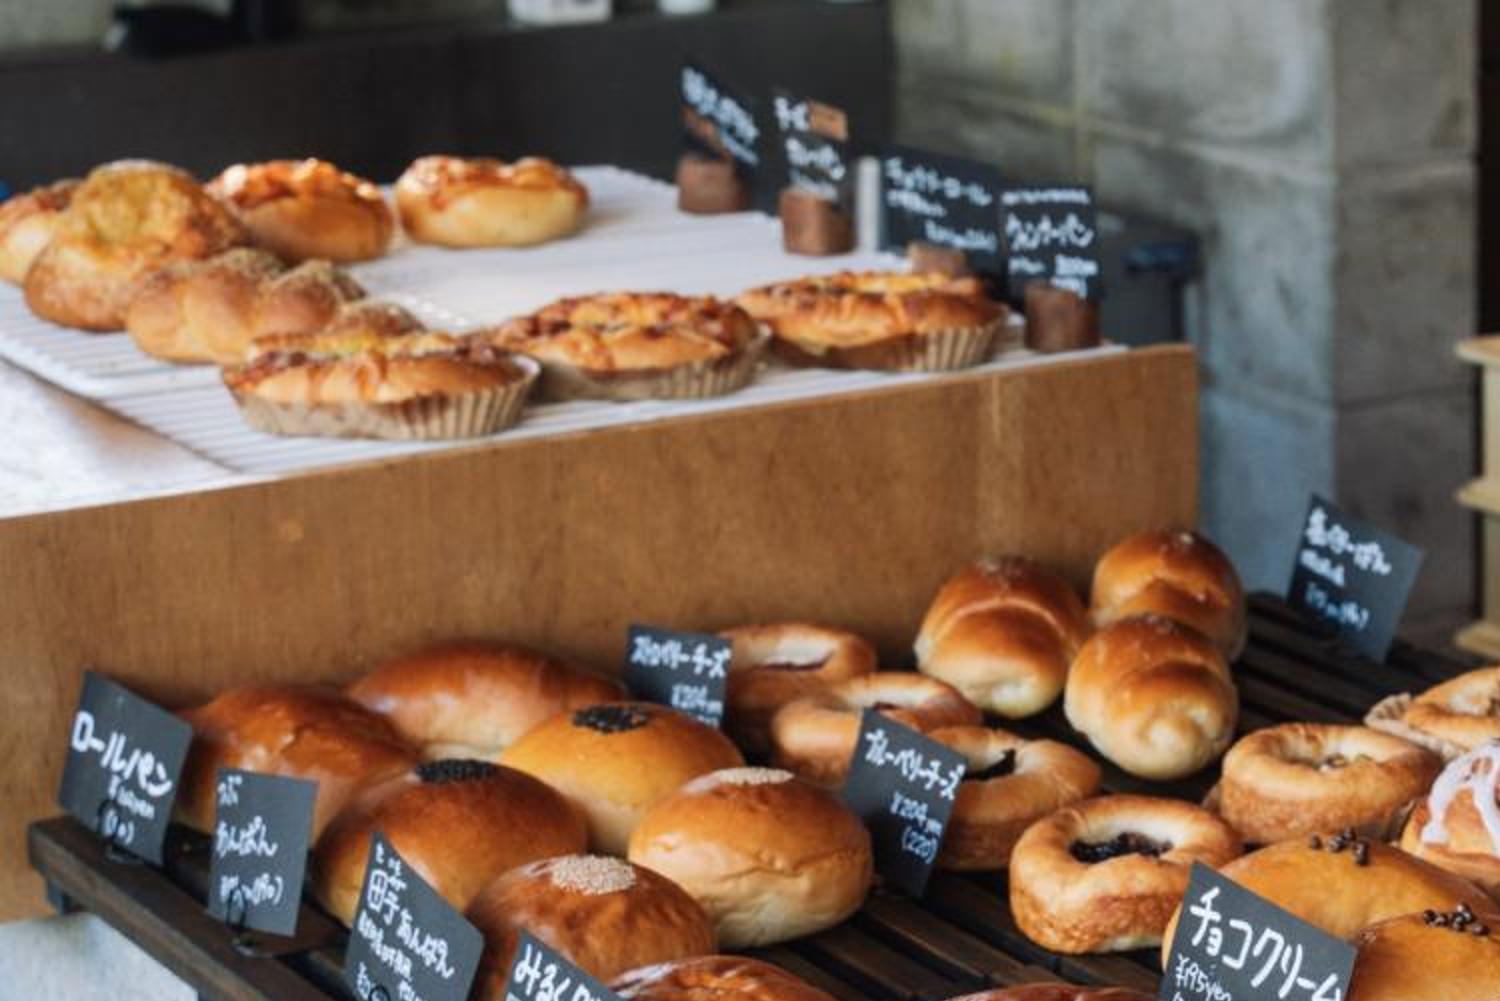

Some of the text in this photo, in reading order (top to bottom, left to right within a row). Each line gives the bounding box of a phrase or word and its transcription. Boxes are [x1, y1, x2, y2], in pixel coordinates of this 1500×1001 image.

[71, 710, 172, 797] ロールパン
